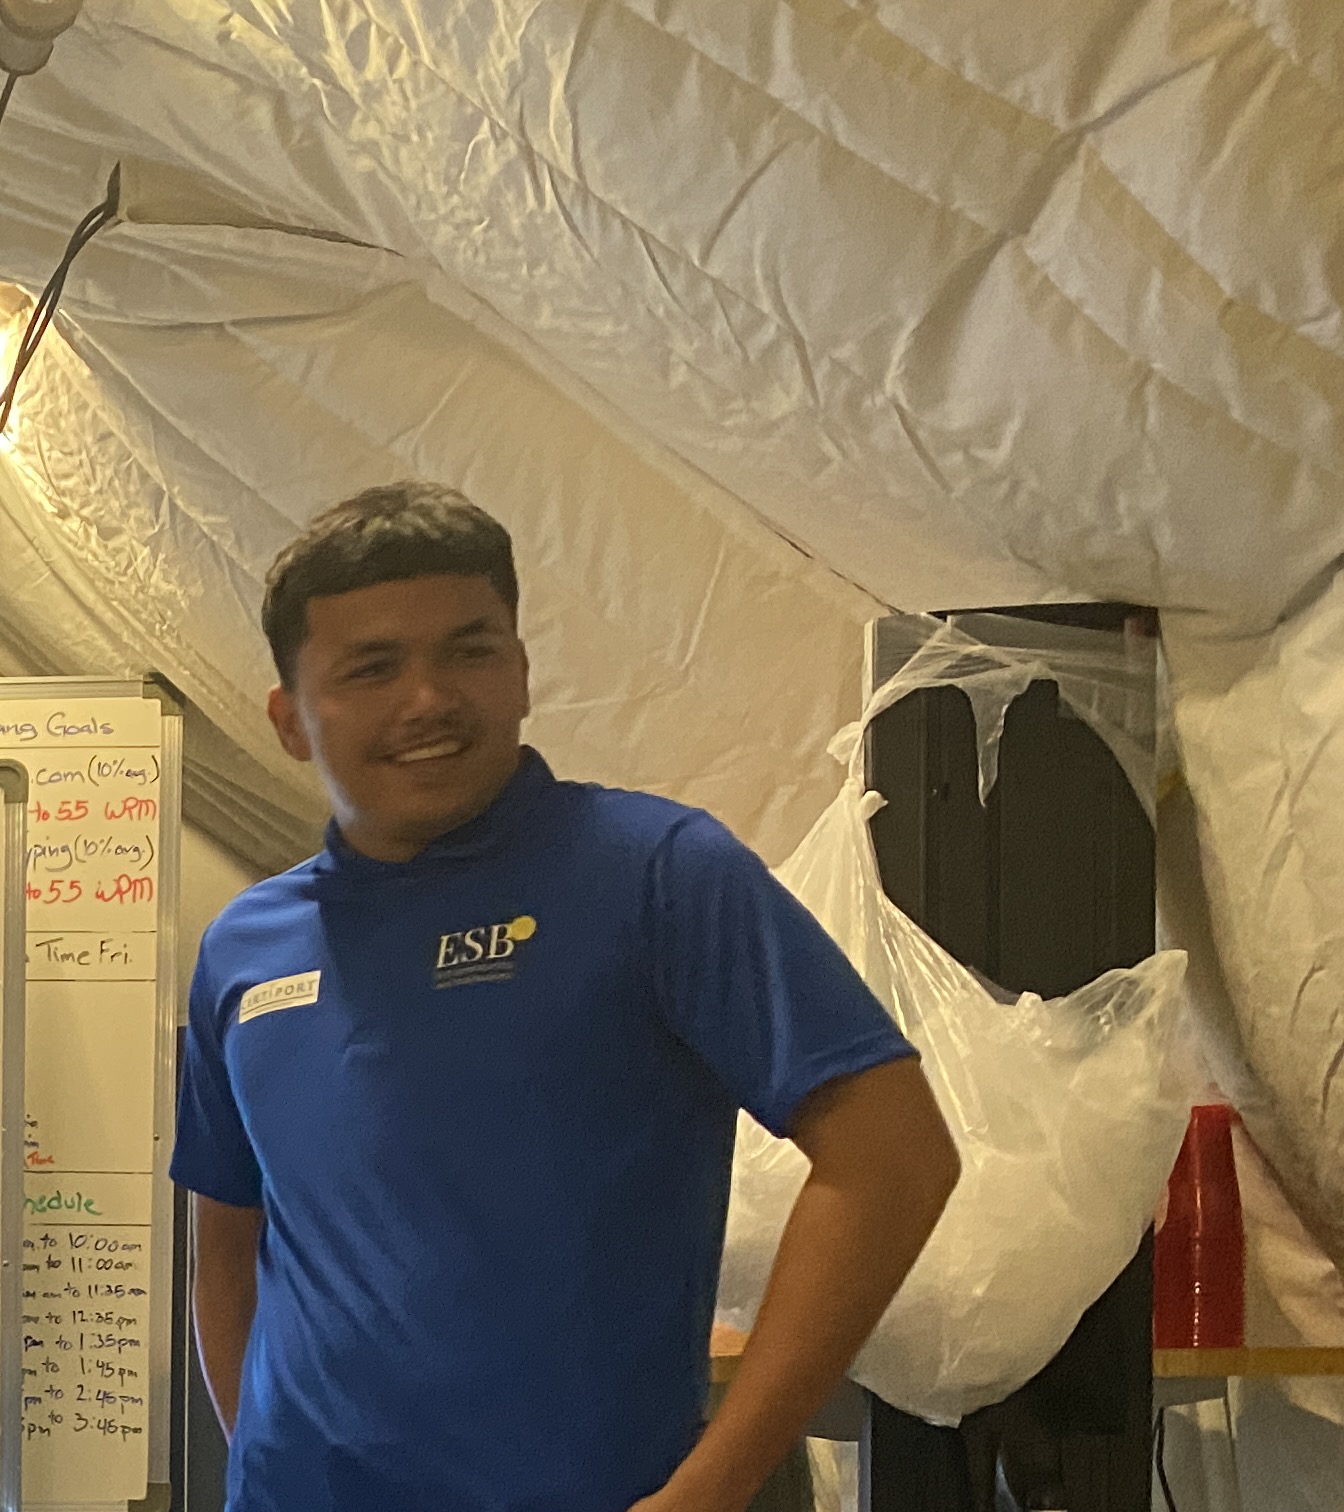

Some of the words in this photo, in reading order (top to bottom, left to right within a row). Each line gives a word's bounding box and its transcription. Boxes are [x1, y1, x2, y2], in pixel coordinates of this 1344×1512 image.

[46, 712, 114, 738] Goals
[28, 801, 50, 822] to
[55, 800, 89, 821] 55
[25, 881, 42, 900] to
[43, 880, 82, 904] 55
[36, 937, 90, 965] Time
[100, 938, 133, 965] Fri.
[436, 923, 515, 969] ESB
[40, 1233, 58, 1248] to
[46, 1254, 61, 1270] to
[64, 1282, 80, 1297] to
[45, 1312, 62, 1324] to
[56, 1335, 72, 1350] to
[42, 1357, 60, 1372] to
[44, 1385, 64, 1399] to
[48, 1410, 63, 1424] to
